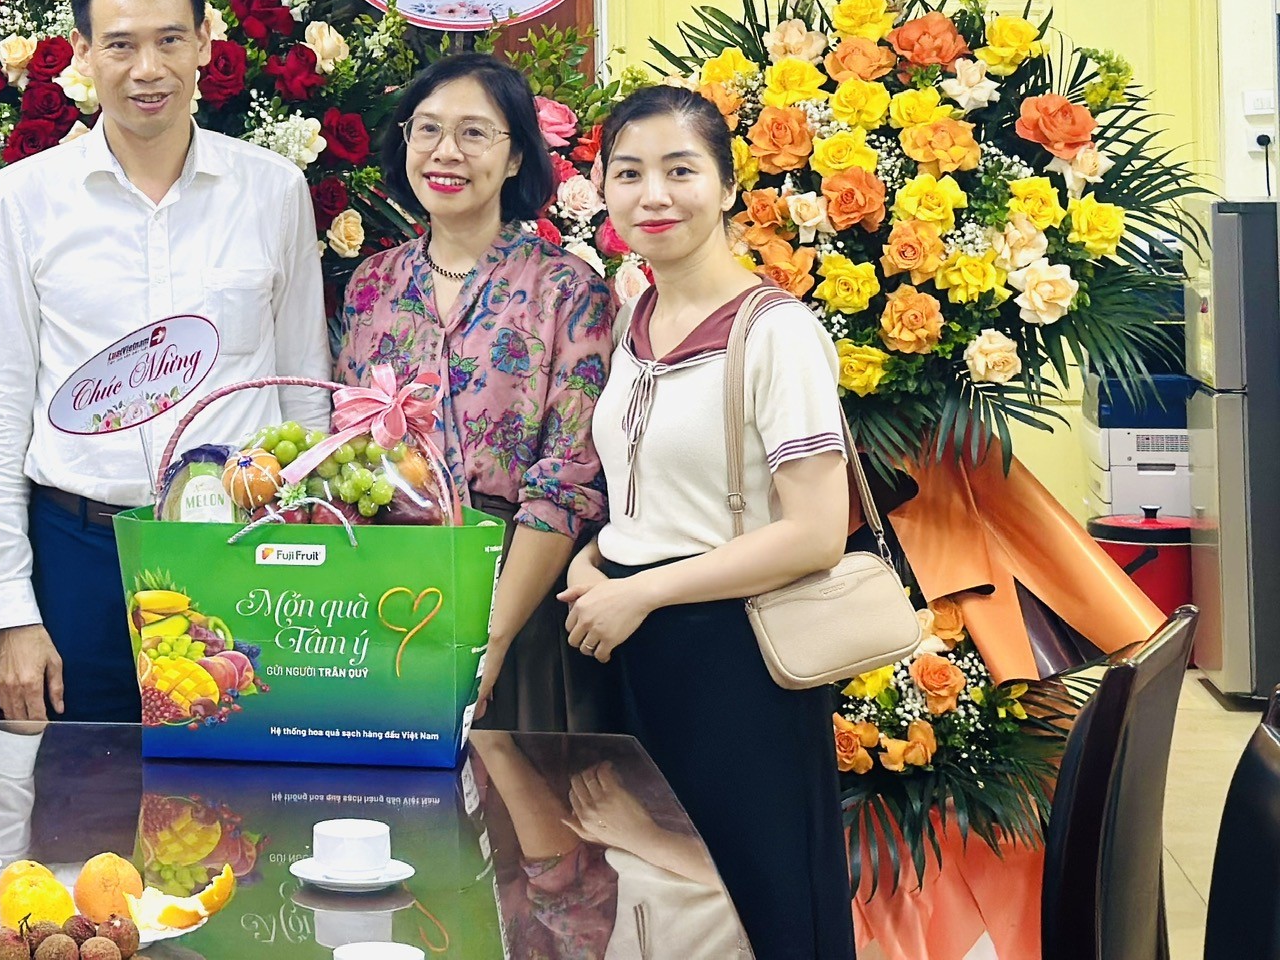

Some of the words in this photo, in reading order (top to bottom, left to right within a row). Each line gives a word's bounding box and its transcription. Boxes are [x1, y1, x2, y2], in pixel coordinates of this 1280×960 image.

[71, 375, 123, 411] Chúc
[128, 344, 202, 389] Mừng
[186, 494, 224, 509] MELON
[276, 550, 295, 561] Fuji
[295, 550, 319, 561] Fruit
[235, 589, 314, 629] Món
[320, 593, 369, 628] quà
[275, 625, 345, 655] Tâm
[349, 630, 369, 666] ý
[266, 664, 283, 676] GỬI
[285, 665, 316, 677] NGƯỜI
[318, 666, 346, 678] TRÂN
[348, 667, 369, 679] QUÝ
[270, 726, 281, 736] Hệ
[283, 726, 306, 738] thống
[308, 728, 324, 736] hoa
[325, 728, 340, 738] quả
[342, 729, 361, 739] sạch
[363, 730, 383, 740] hàng
[384, 730, 400, 739] đầu
[401, 731, 418, 741] Việt
[420, 732, 439, 741] Nam
